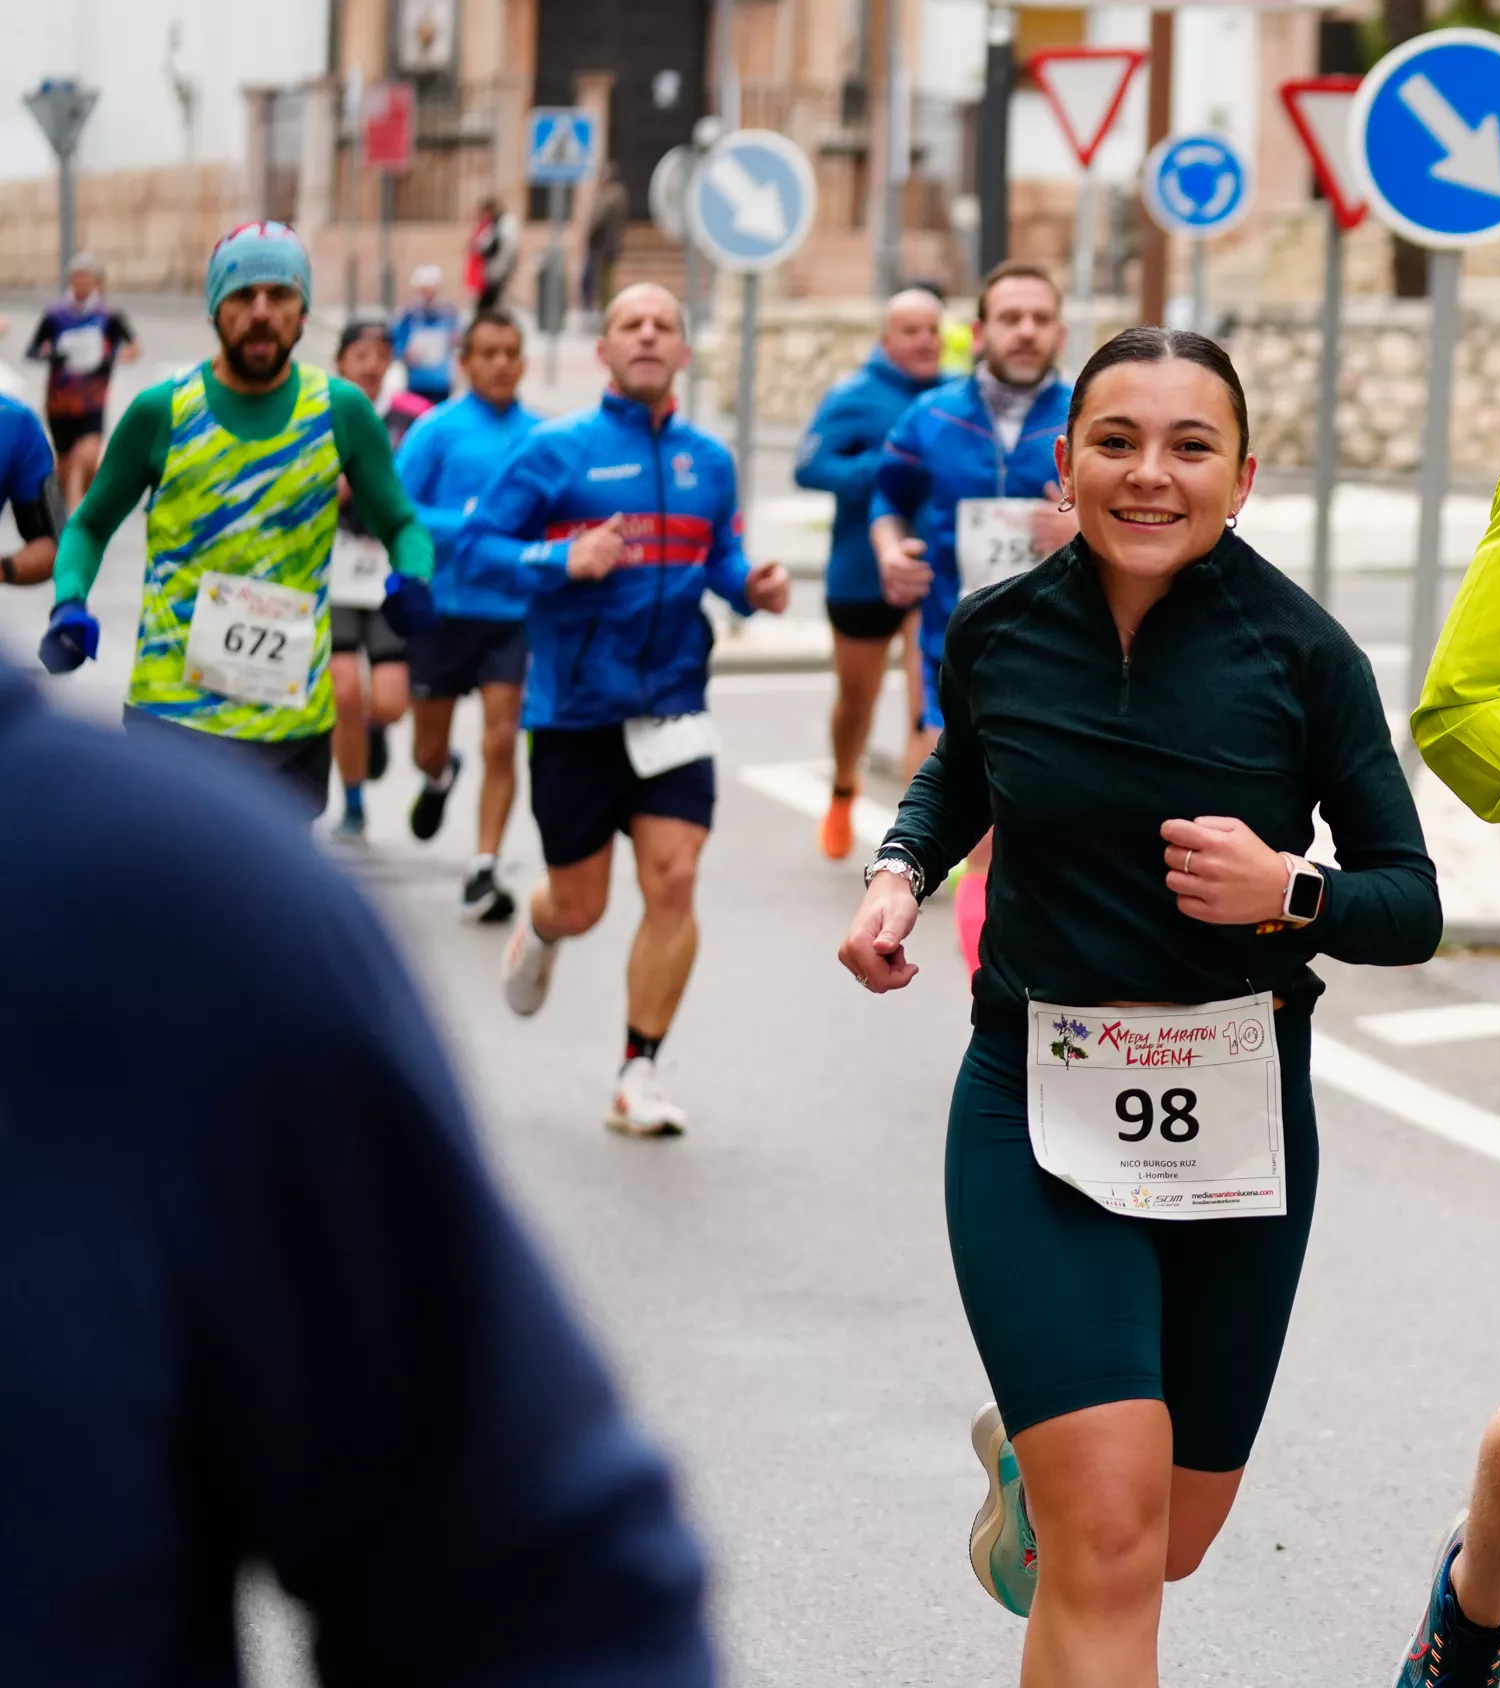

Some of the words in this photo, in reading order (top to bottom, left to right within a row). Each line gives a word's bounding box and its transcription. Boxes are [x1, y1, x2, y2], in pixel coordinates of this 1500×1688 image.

[223, 622, 287, 663] 672
[1126, 1046, 1203, 1067] LUCENA
[1115, 1088, 1200, 1143] 98
[1120, 1160, 1141, 1168] NICO
[1143, 1160, 1178, 1168] BURGOS
[1138, 1171, 1179, 1179] L-Hombre
[1191, 1189, 1274, 1199] mediamaratonlucena.com
